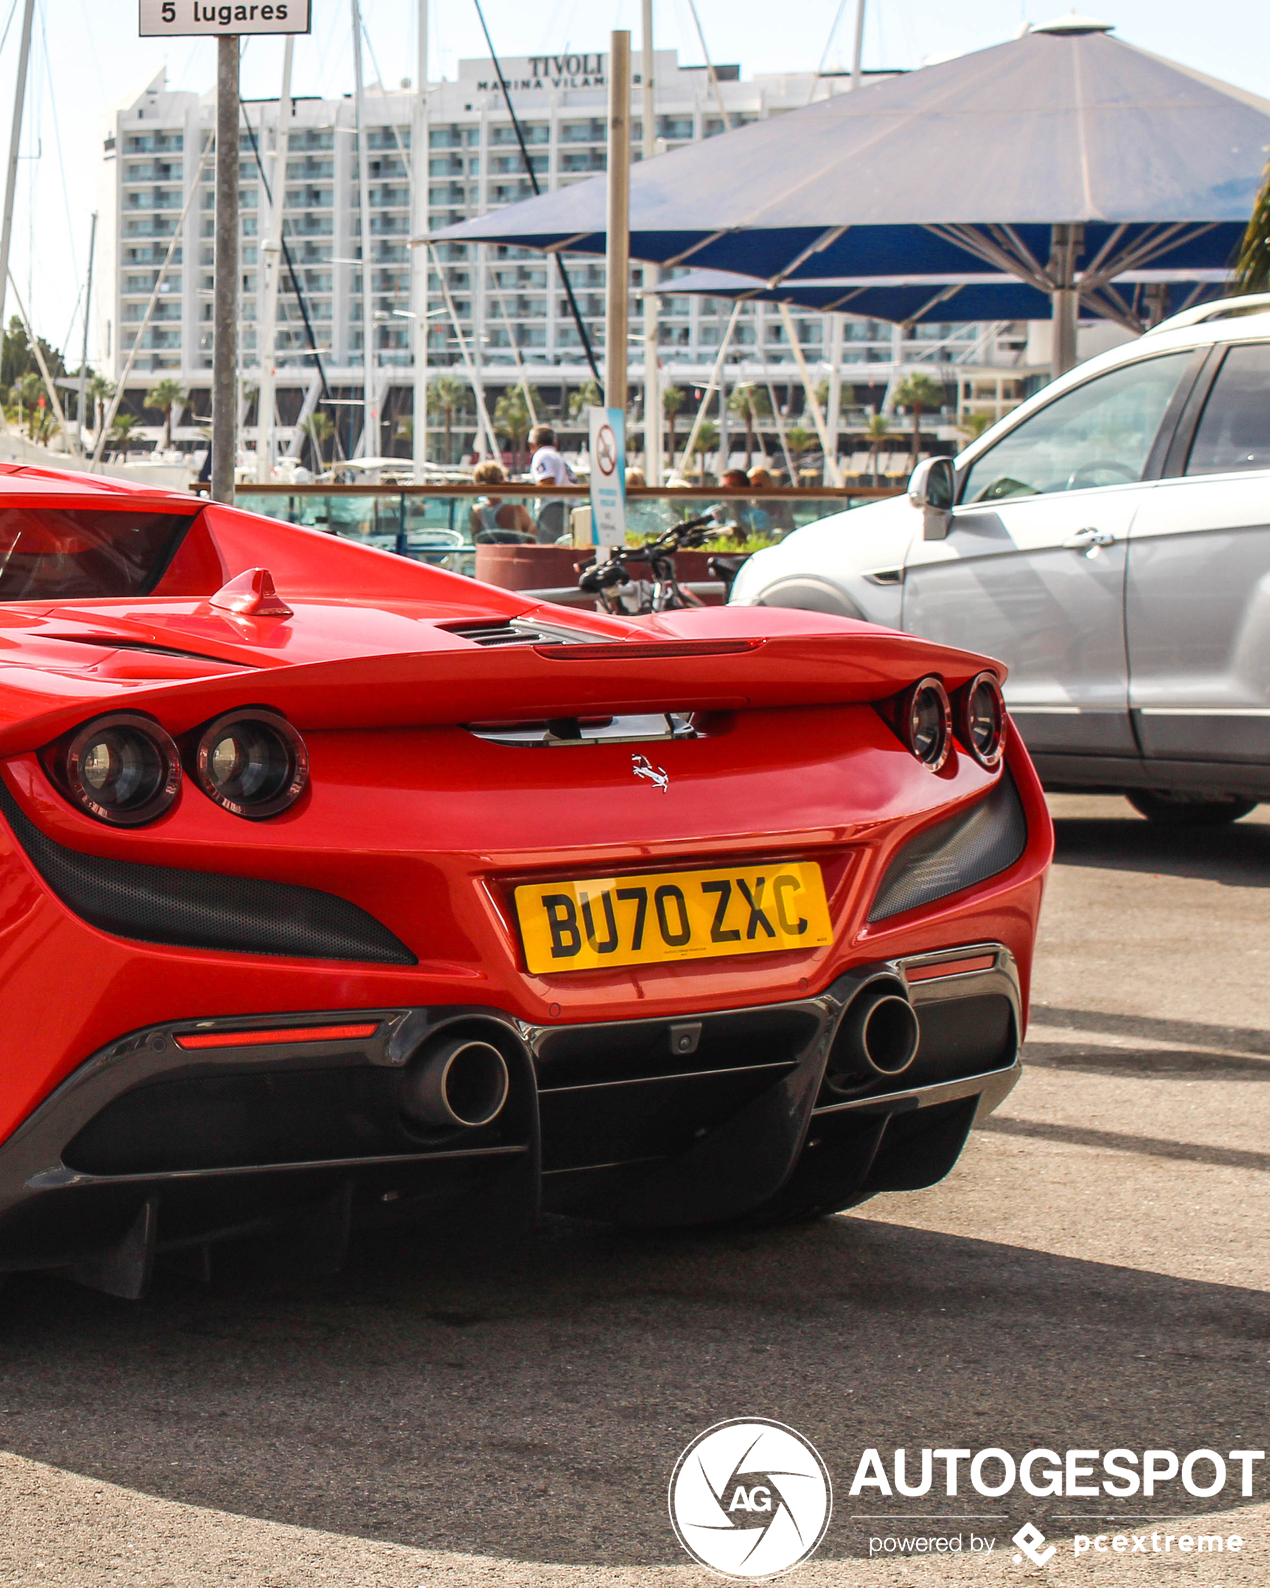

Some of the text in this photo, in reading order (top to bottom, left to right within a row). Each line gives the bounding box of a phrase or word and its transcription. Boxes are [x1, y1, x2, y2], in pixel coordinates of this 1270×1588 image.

[161, 1, 288, 25] 5 lugares
[528, 53, 604, 78] TIVOLI
[477, 78, 543, 92] MARINA
[541, 874, 808, 958] BU70 ZXC
